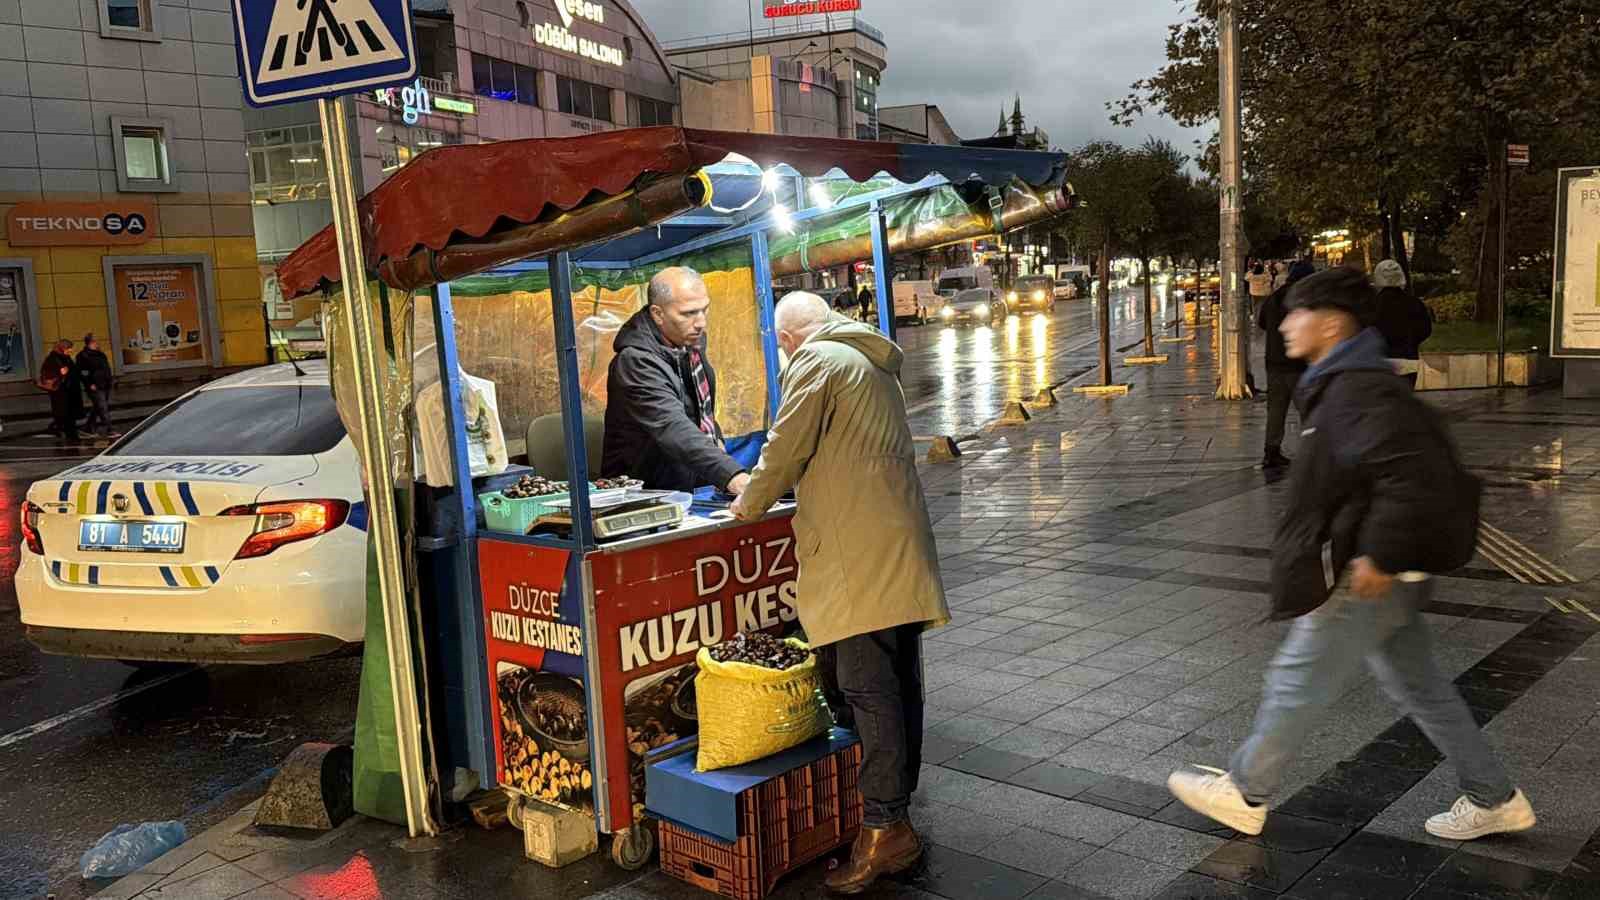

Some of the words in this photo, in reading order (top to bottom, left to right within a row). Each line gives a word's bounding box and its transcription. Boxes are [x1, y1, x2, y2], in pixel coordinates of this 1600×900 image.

[579, 38, 623, 66] SALONU
[15, 215, 145, 232] TEKNOSA
[128, 283, 148, 300] 12
[155, 461, 264, 477] POLİSİ
[88, 522, 105, 544] 81
[119, 522, 129, 544] A
[141, 523, 179, 546] 5440
[508, 581, 561, 618] DÜZCE
[490, 610, 521, 643] KUZU
[619, 600, 723, 672] KUZU
